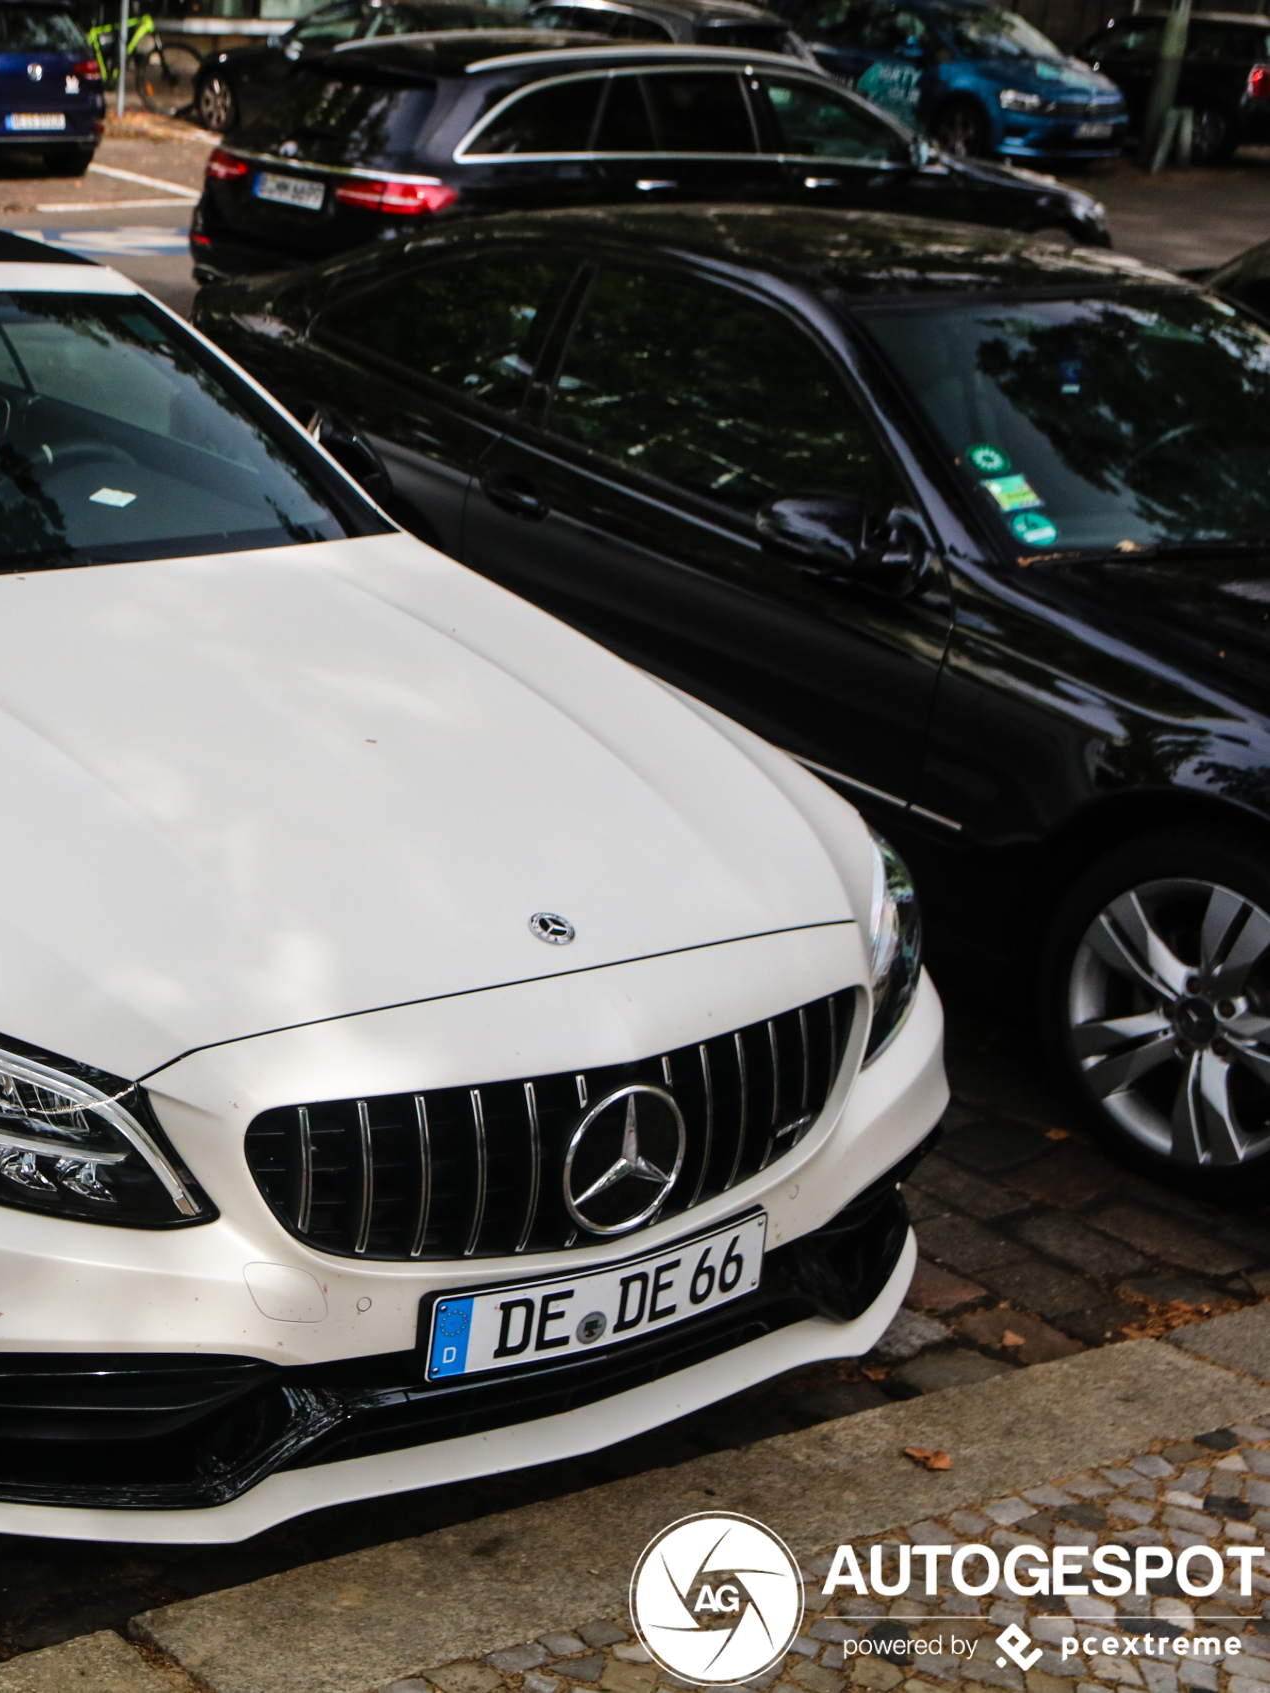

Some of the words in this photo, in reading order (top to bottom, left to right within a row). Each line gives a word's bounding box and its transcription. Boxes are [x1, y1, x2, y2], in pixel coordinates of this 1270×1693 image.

[493, 1289, 575, 1359] DE
[612, 1258, 681, 1334] DE
[689, 1234, 744, 1305] 66
[442, 1346, 457, 1364] D
